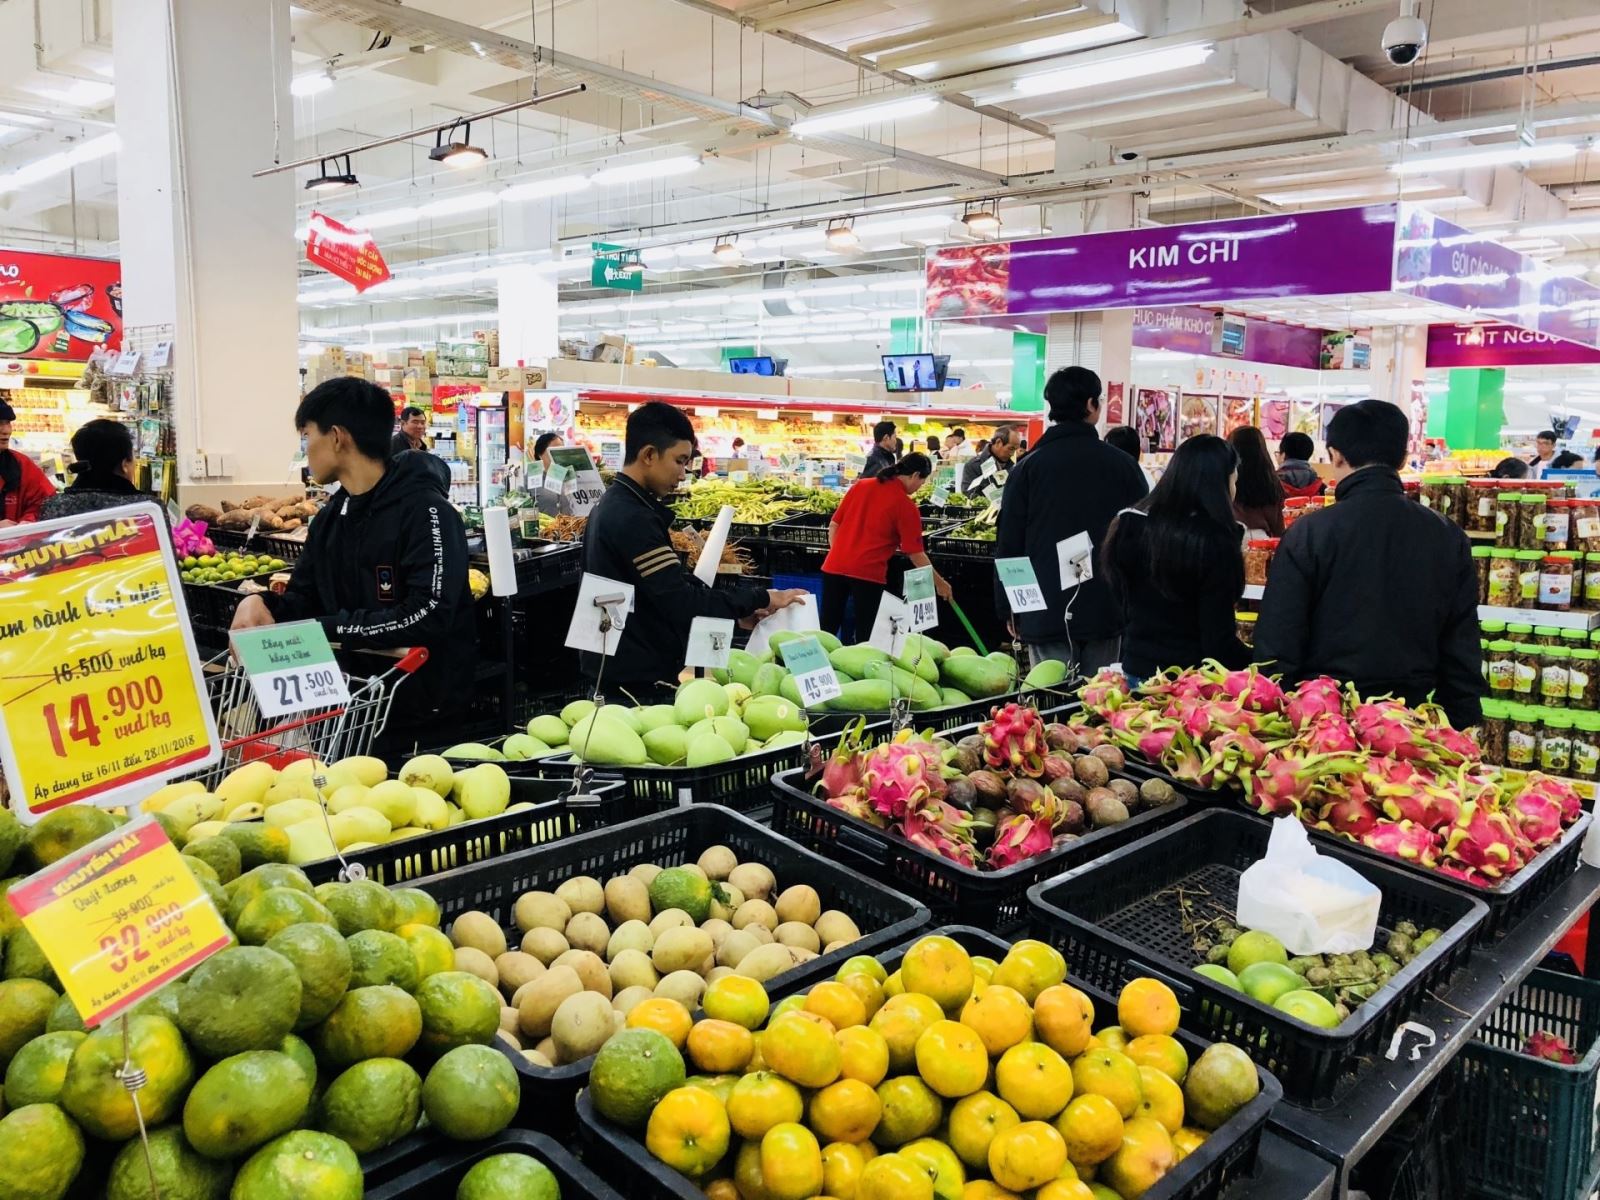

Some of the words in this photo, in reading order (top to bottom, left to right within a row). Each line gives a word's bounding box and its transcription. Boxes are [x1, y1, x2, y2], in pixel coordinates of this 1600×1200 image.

[1129, 245, 1178, 269] KIM
[1188, 239, 1239, 265] CHI
[428, 507, 442, 557] OFF-WHITE
[0, 618, 26, 640] am
[33, 601, 81, 630] sành
[53, 651, 114, 684] 16.500
[119, 644, 166, 668] vnd/kg
[273, 670, 335, 706] 27.500
[43, 675, 164, 758] 14.900
[114, 709, 172, 740] vnd/kg
[34, 784, 49, 800] Áp
[52, 778, 80, 794] dụng
[96, 760, 120, 778] 16/11
[123, 754, 142, 769] đến
[144, 735, 196, 761] 28/11/2018
